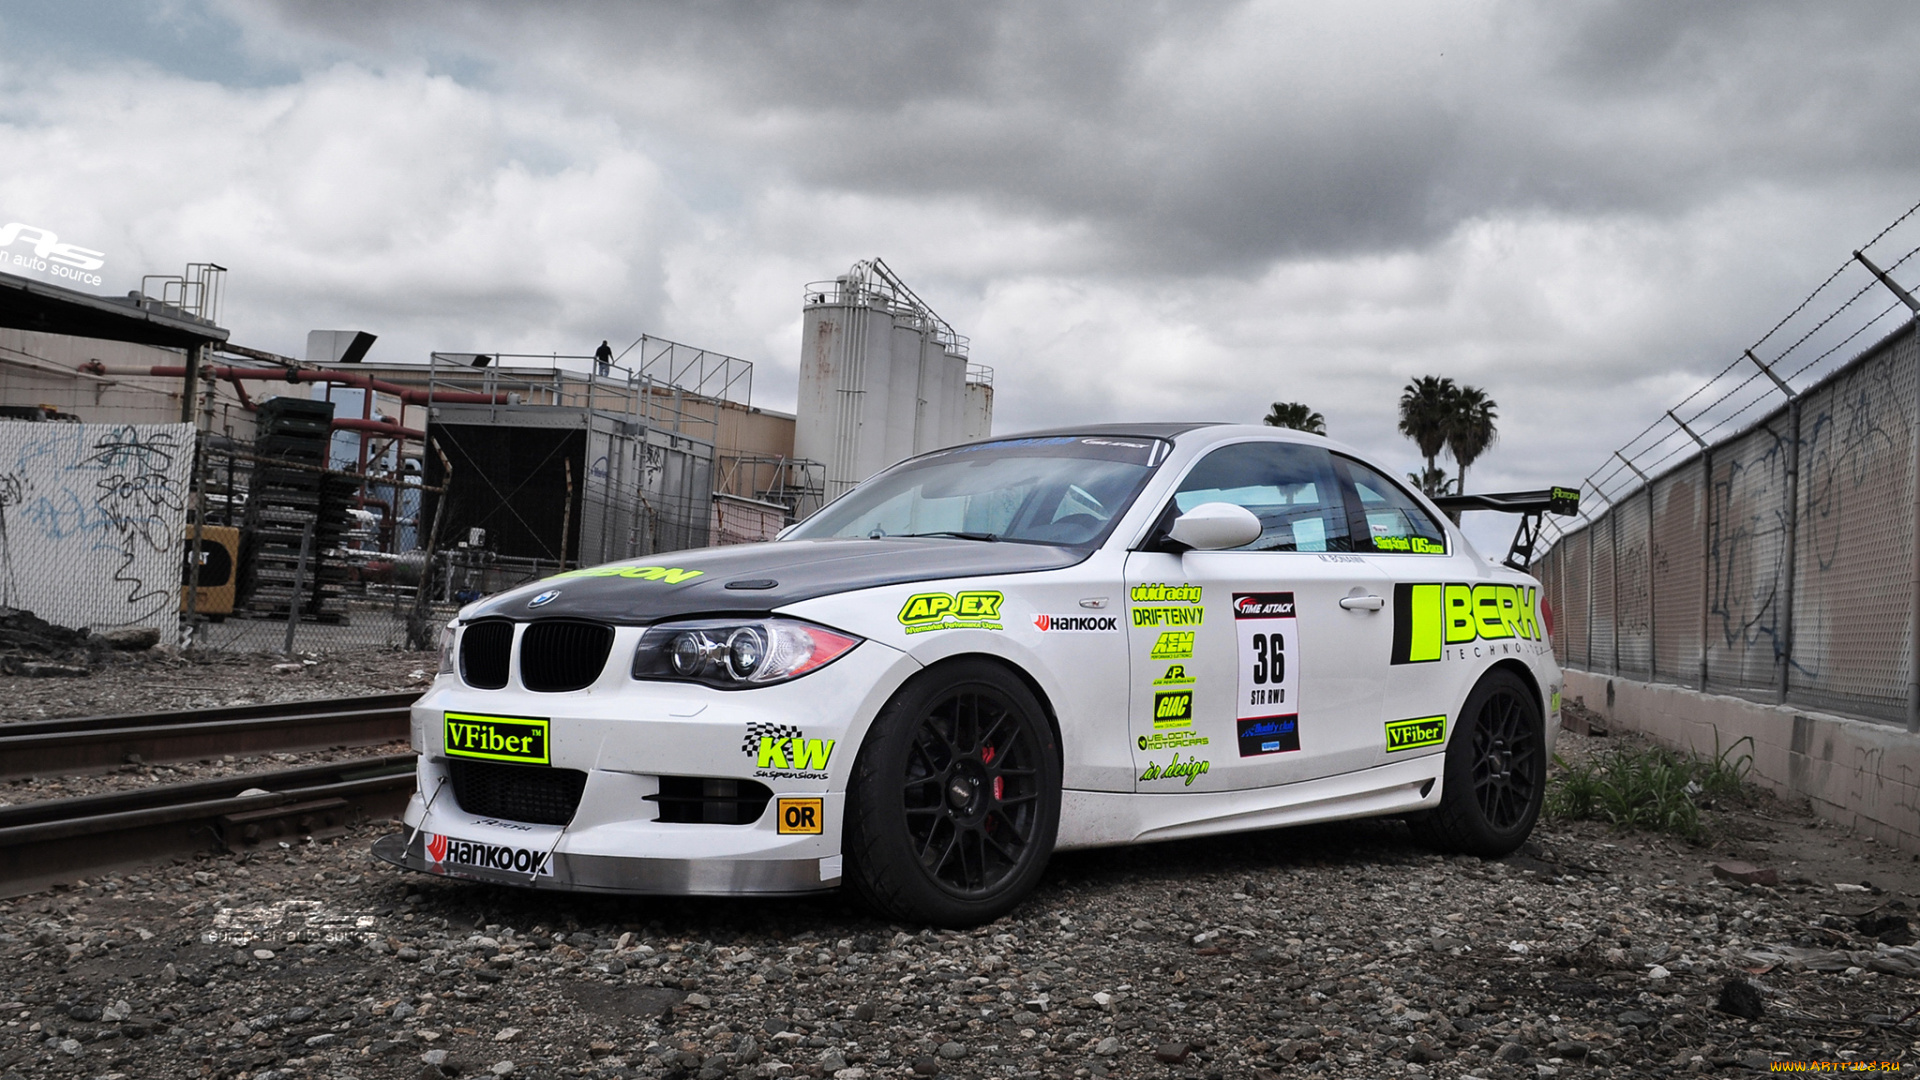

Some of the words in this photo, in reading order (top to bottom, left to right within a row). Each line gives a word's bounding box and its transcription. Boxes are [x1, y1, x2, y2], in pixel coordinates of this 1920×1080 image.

[1131, 583, 1202, 604] vividracing
[1132, 607, 1205, 626] DRIFTENVY
[1240, 603, 1261, 614] TIME
[1262, 602, 1294, 614] ATTACK
[1444, 582, 1541, 645] BERK
[1252, 633, 1285, 685] 36
[1157, 695, 1189, 718] GIAC
[1251, 690, 1266, 706] STR
[1267, 688, 1285, 704] RWD
[1147, 731, 1197, 742] VELOCITY
[1147, 737, 1209, 750] MOTORCARS
[757, 736, 835, 770] KW
[753, 770, 828, 781] suspensions
[1160, 752, 1210, 787] design
[785, 806, 816, 828] OR
